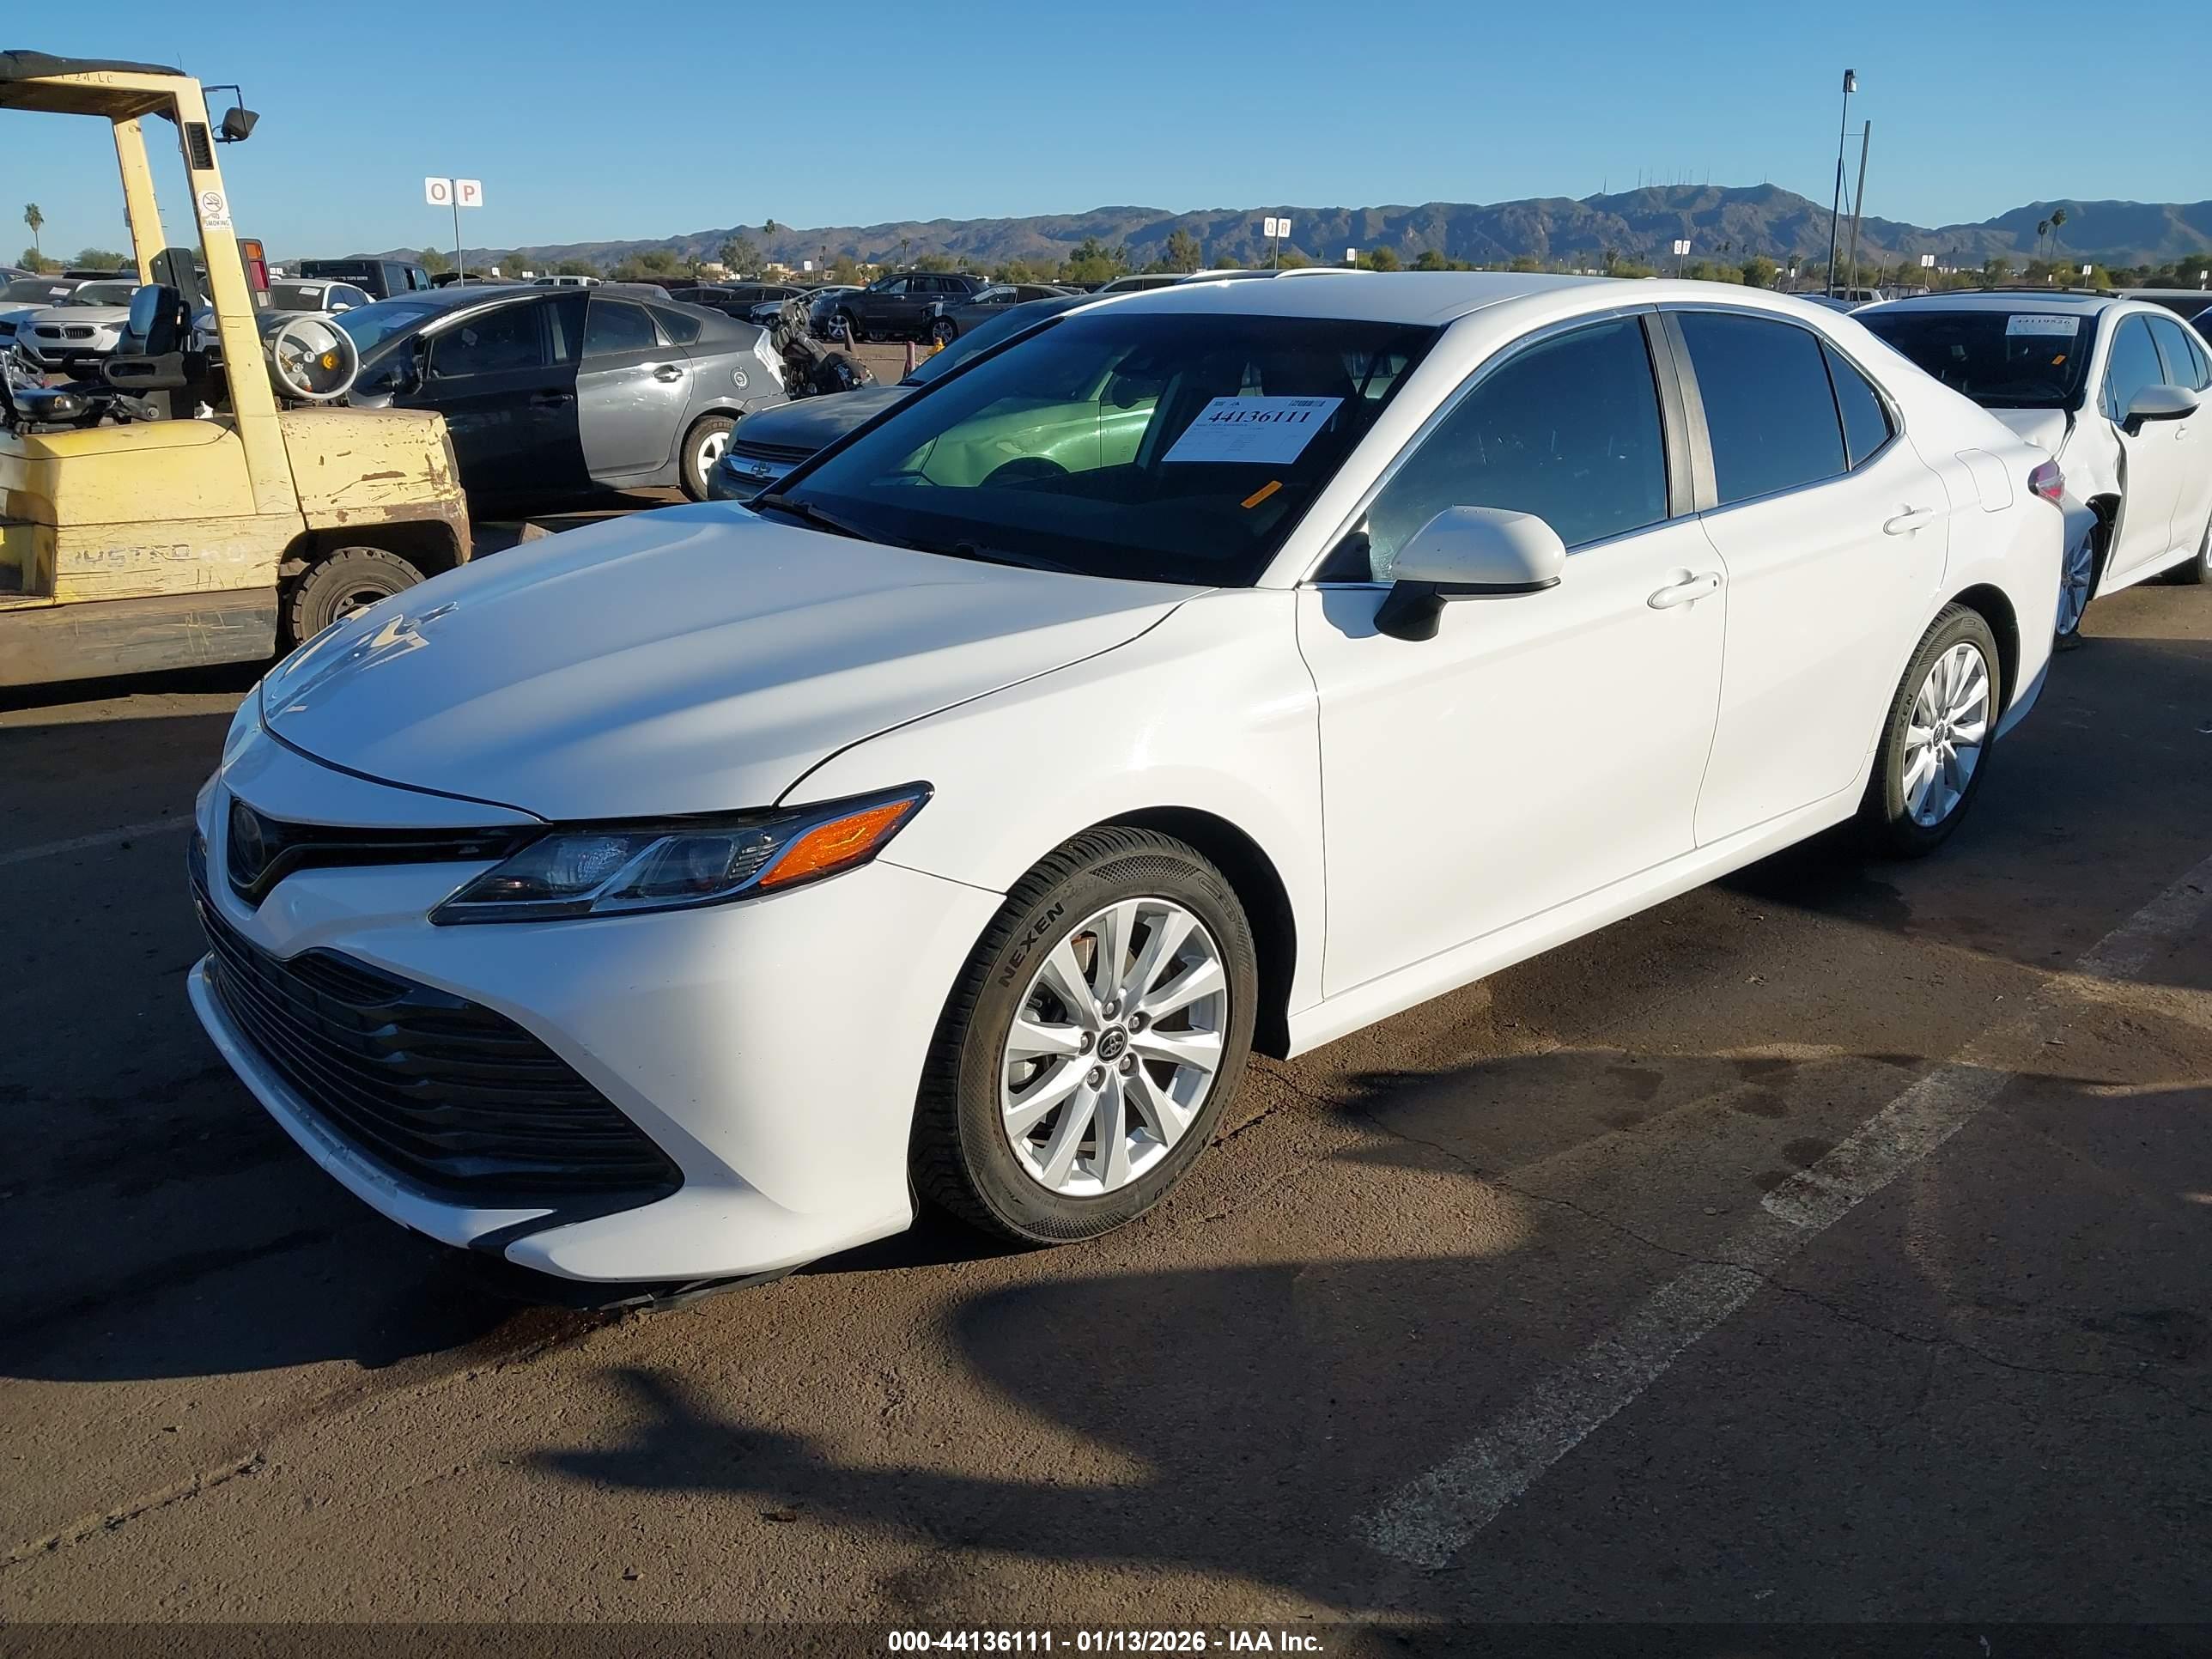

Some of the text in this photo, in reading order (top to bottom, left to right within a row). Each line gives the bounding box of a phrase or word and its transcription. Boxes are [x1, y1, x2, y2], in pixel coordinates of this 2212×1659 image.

[431, 183, 446, 200] O
[464, 185, 475, 202] P
[1280, 222, 1288, 234] R
[1675, 242, 1681, 252] S
[1684, 242, 1689, 252] T
[1208, 410, 1311, 422] 44136111
[998, 901, 1065, 988] NEXEN
